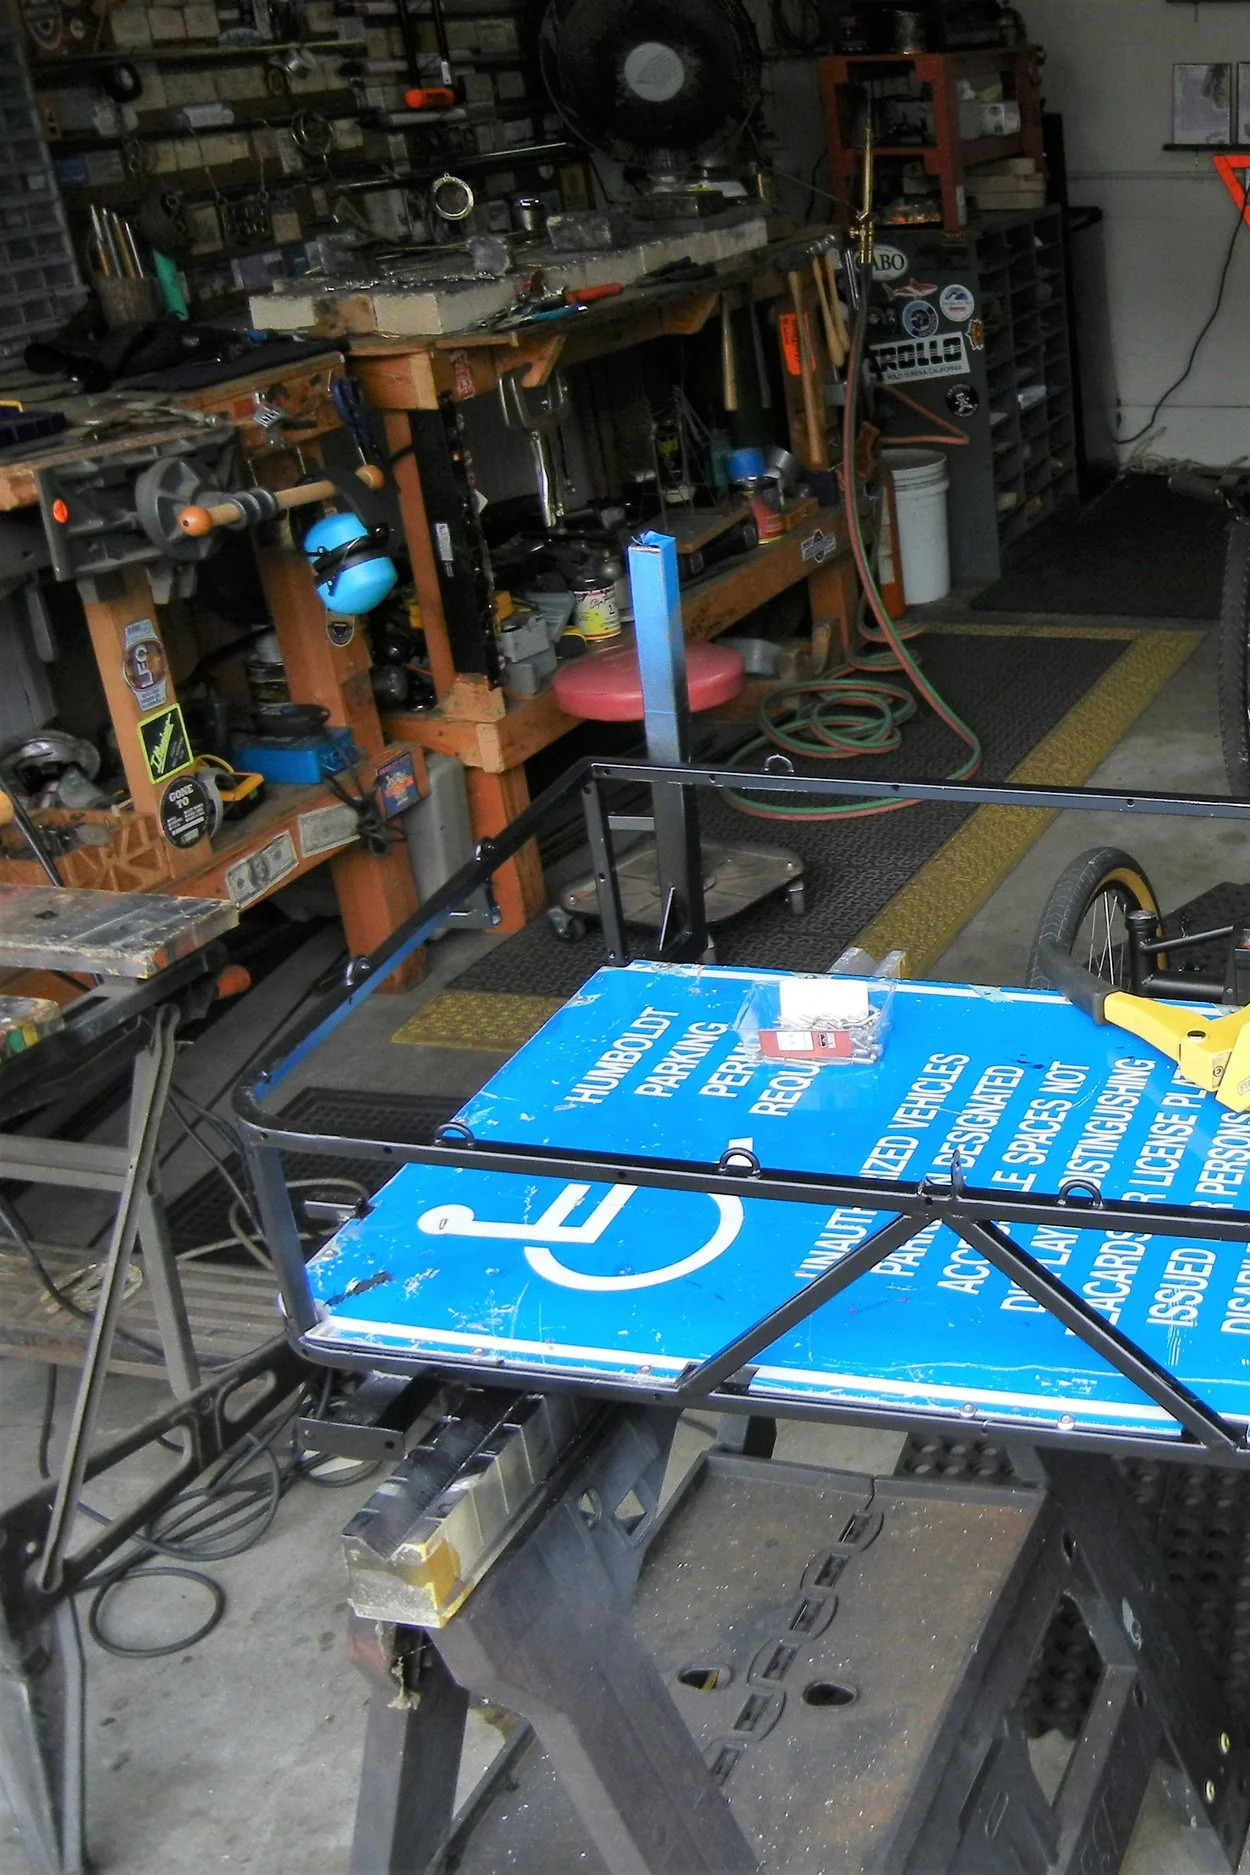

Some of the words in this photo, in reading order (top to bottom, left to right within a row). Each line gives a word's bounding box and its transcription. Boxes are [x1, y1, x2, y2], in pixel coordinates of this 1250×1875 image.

[168, 783, 195, 803] GONE
[175, 796, 191, 809] TO
[564, 1006, 679, 1104] HUMBOLDT
[633, 1022, 728, 1098] PARKING
[887, 1053, 971, 1129] VEHICLES
[932, 1065, 1025, 1168] DESIGNATED
[1002, 1099, 1073, 1166] SPACES
[1039, 1061, 1090, 1095] NOT
[1129, 1112, 1198, 1187] LICENSE
[1146, 1248, 1217, 1328] ISSUED
